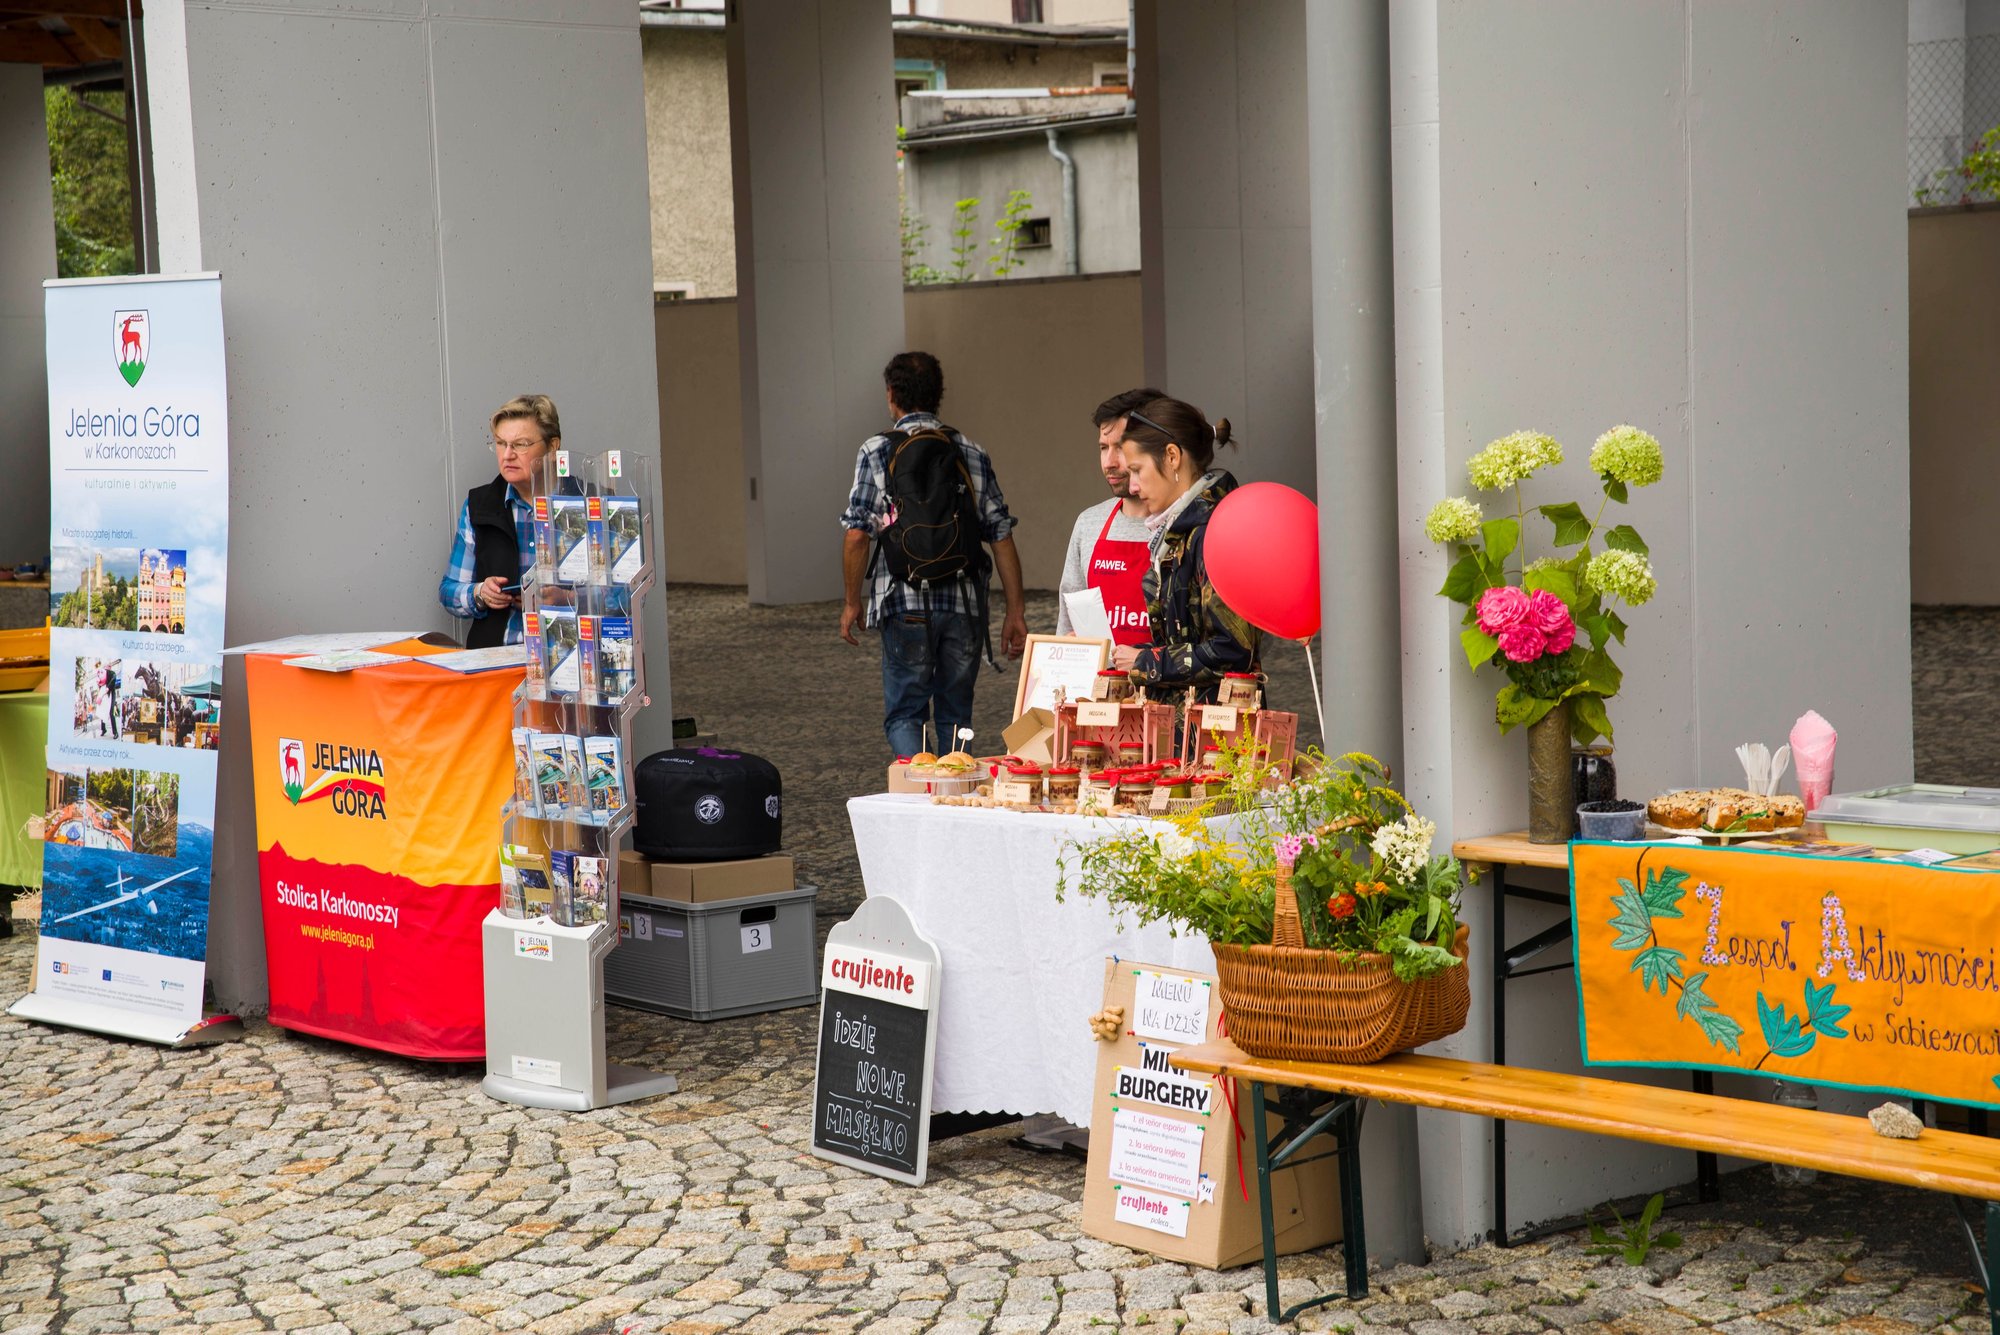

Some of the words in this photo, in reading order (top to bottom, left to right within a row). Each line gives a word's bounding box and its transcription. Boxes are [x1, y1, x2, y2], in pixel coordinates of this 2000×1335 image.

[65, 407, 137, 438] Jelenia
[143, 406, 200, 438] Góra
[84, 446, 94, 459] w
[96, 443, 176, 460] Karkonoszach
[84, 479, 131, 490] kulturalnie
[139, 479, 177, 491] aktywnie
[86, 528, 110, 541] bogatej
[1094, 559, 1127, 571] PAWEŁ
[122, 639, 144, 651] Kultura
[145, 641, 155, 651] dla
[84, 747, 100, 758] przez
[311, 742, 384, 778] JELENIA
[332, 780, 387, 820] GÓRA
[276, 880, 318, 911] Stolica
[321, 888, 399, 929] Karkonoszy
[300, 922, 375, 950] www.jeleniagora.pl
[640, 916, 647, 936] 3
[527, 936, 549, 946] JELENIA
[749, 928, 761, 948] 3
[831, 957, 914, 994] crujiente
[1151, 979, 1193, 1003] MENU
[1142, 1008, 1160, 1029] NA
[1164, 1010, 1201, 1035] DZIŚ
[1854, 1023, 1874, 1042] w
[1119, 1074, 1208, 1111] BURGERY
[825, 1102, 908, 1155] MASEŁKO
[1138, 1116, 1144, 1124] el
[1135, 1140, 1142, 1149] la
[1143, 1143, 1163, 1154] señora
[1164, 1147, 1186, 1159] inglesa
[1125, 1162, 1132, 1171] la
[1158, 1172, 1191, 1186] americana
[1120, 1195, 1168, 1216] crujiente
